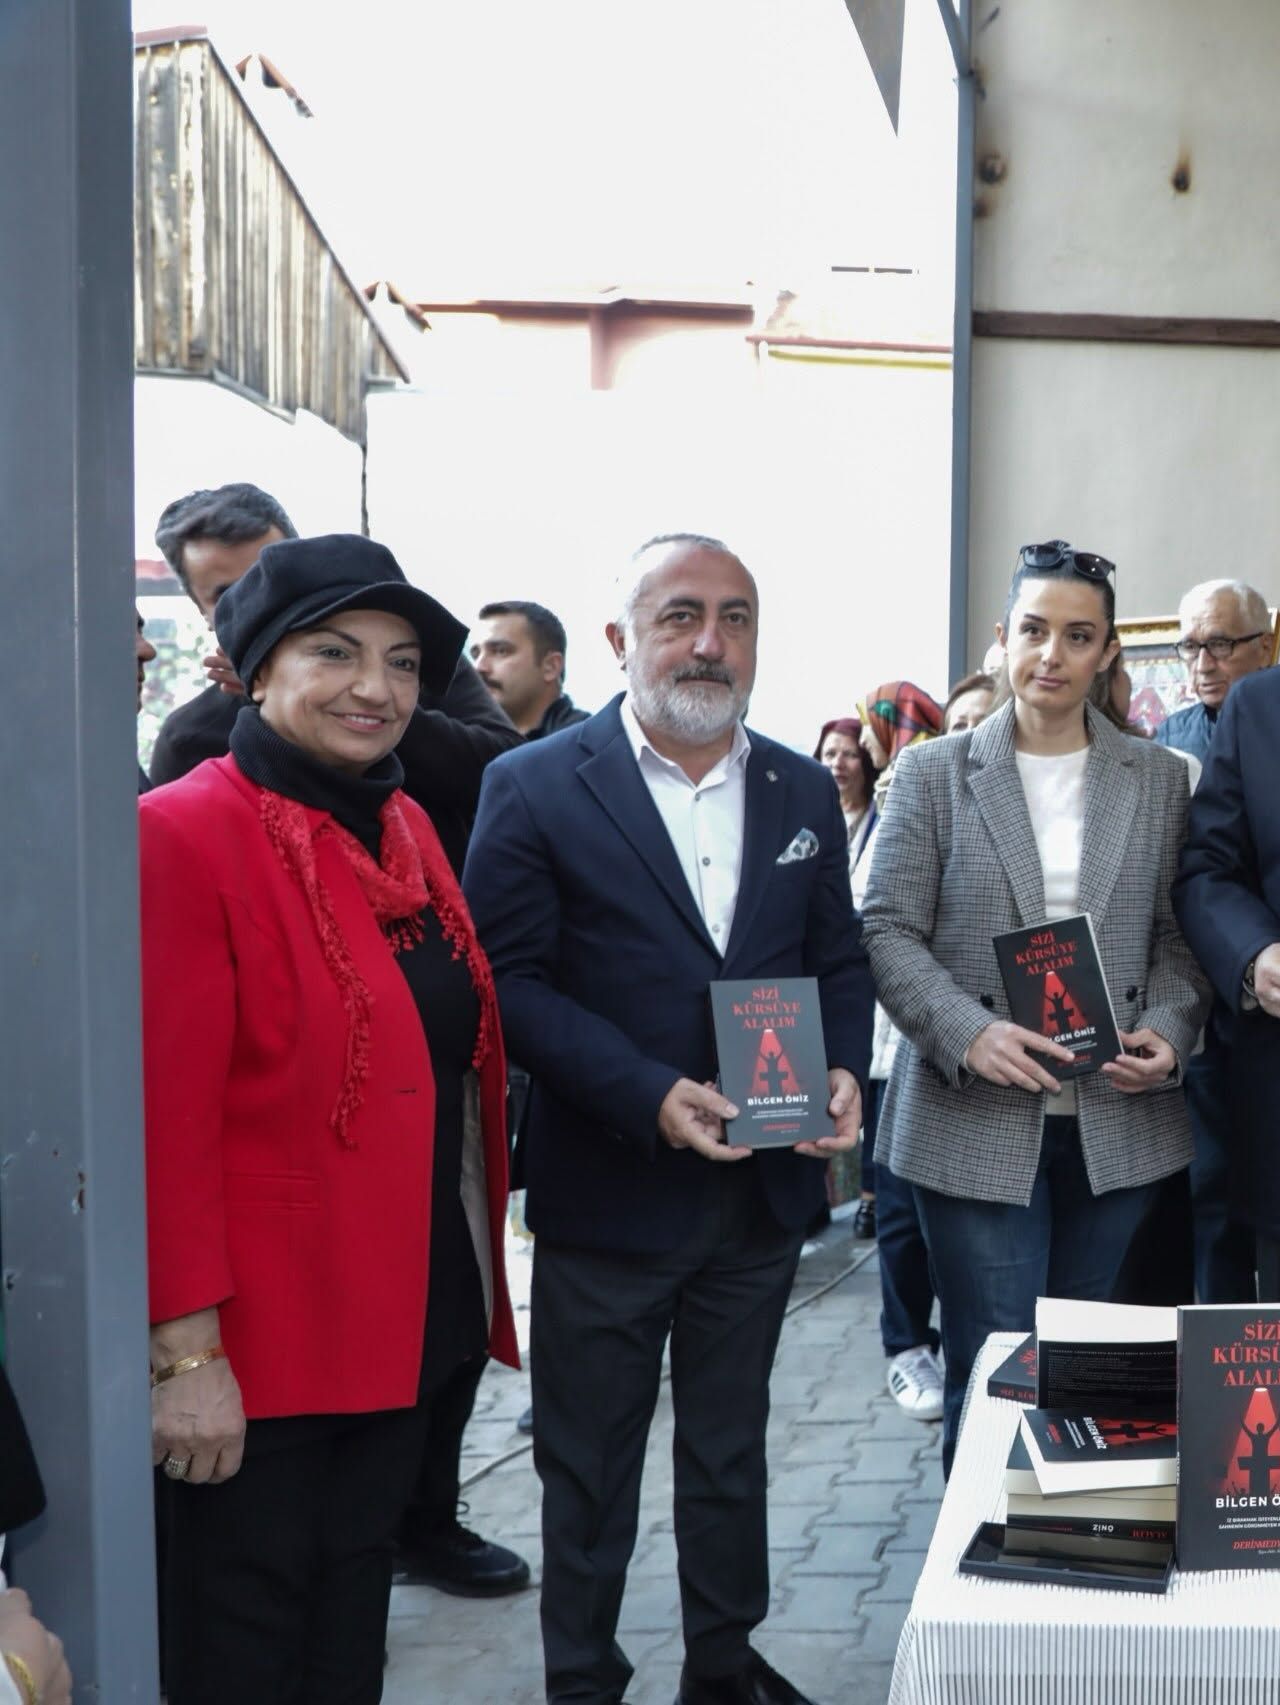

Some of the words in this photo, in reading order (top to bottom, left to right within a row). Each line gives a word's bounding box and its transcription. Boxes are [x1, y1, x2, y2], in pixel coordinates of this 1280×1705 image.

[1030, 930, 1056, 946] SİZİ
[1015, 940, 1078, 966] KÜRSÜYE
[1027, 956, 1075, 975] ALALIM
[751, 985, 780, 1000] SİZİ
[732, 1000, 801, 1016] KÜRSÜYE
[742, 1015, 796, 1030] ALALIM
[747, 1096, 783, 1106] BİLGEN
[785, 1093, 809, 1104] ÖNİZ
[1215, 1495, 1268, 1509] BİLGEN
